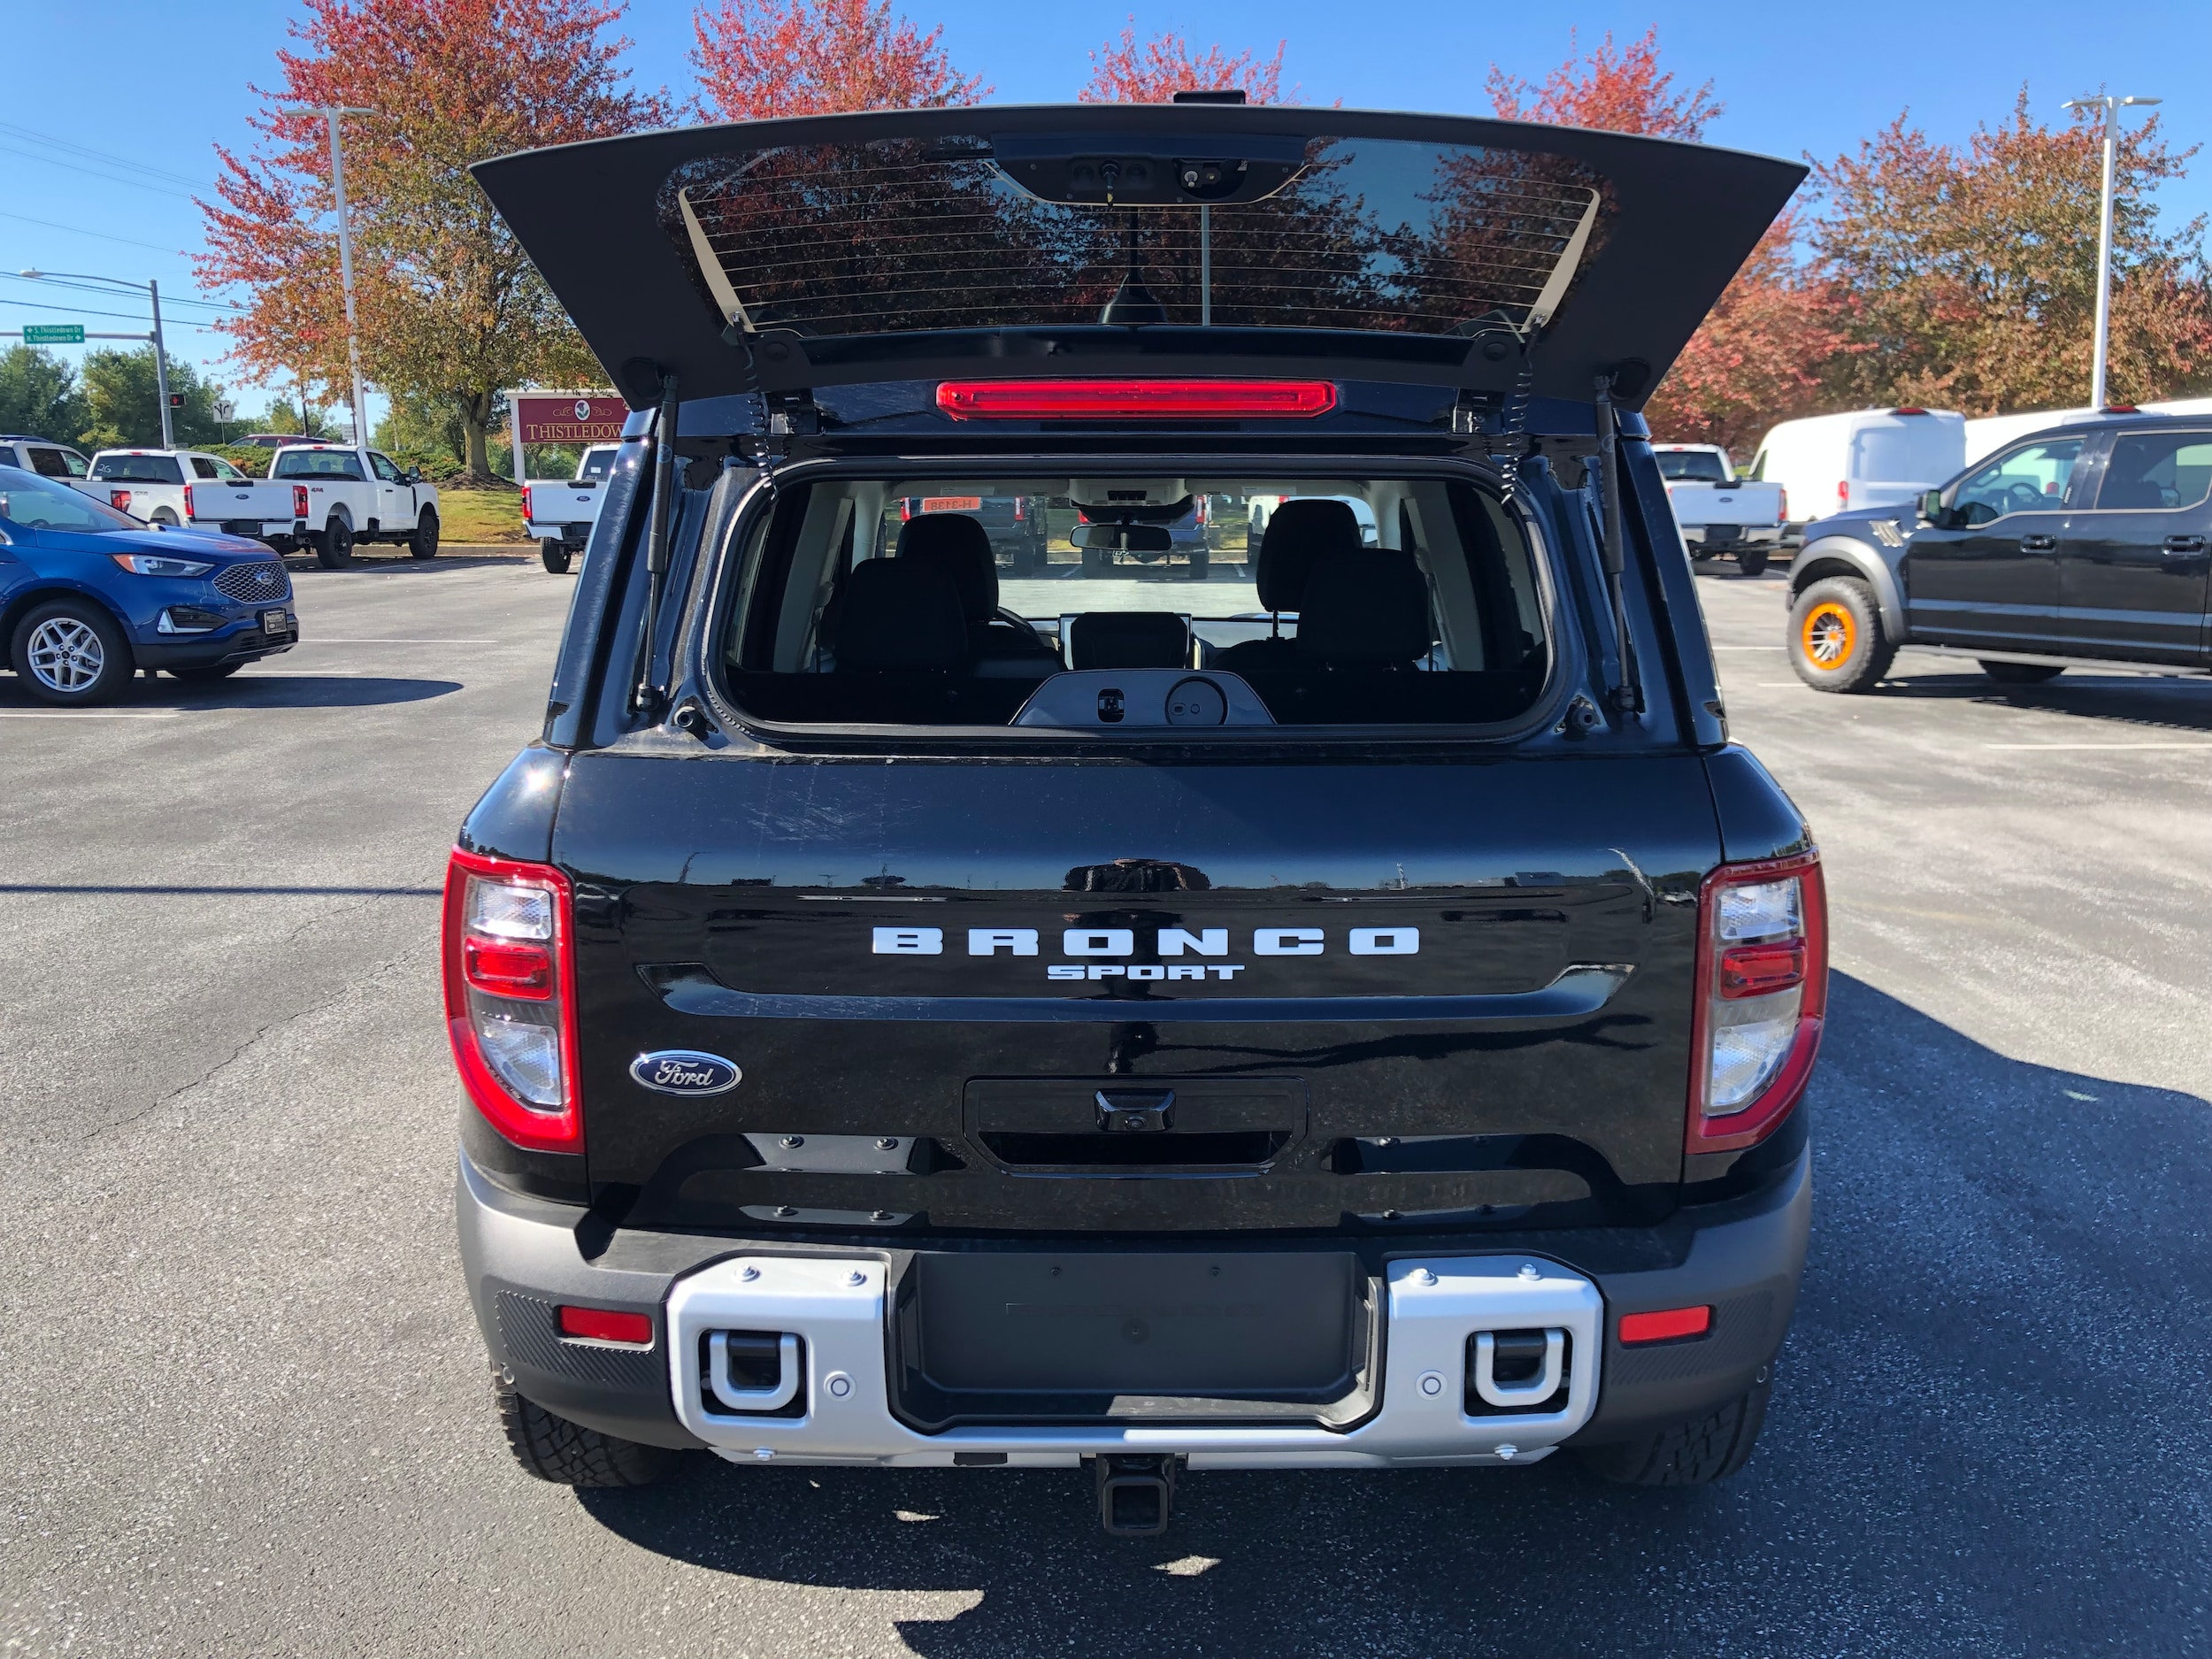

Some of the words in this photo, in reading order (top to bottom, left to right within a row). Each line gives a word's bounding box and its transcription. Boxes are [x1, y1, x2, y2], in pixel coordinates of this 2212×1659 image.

[872, 926, 1421, 956] BRONCO
[1047, 964, 1246, 980] SPORT
[654, 1059, 714, 1087] Ford
